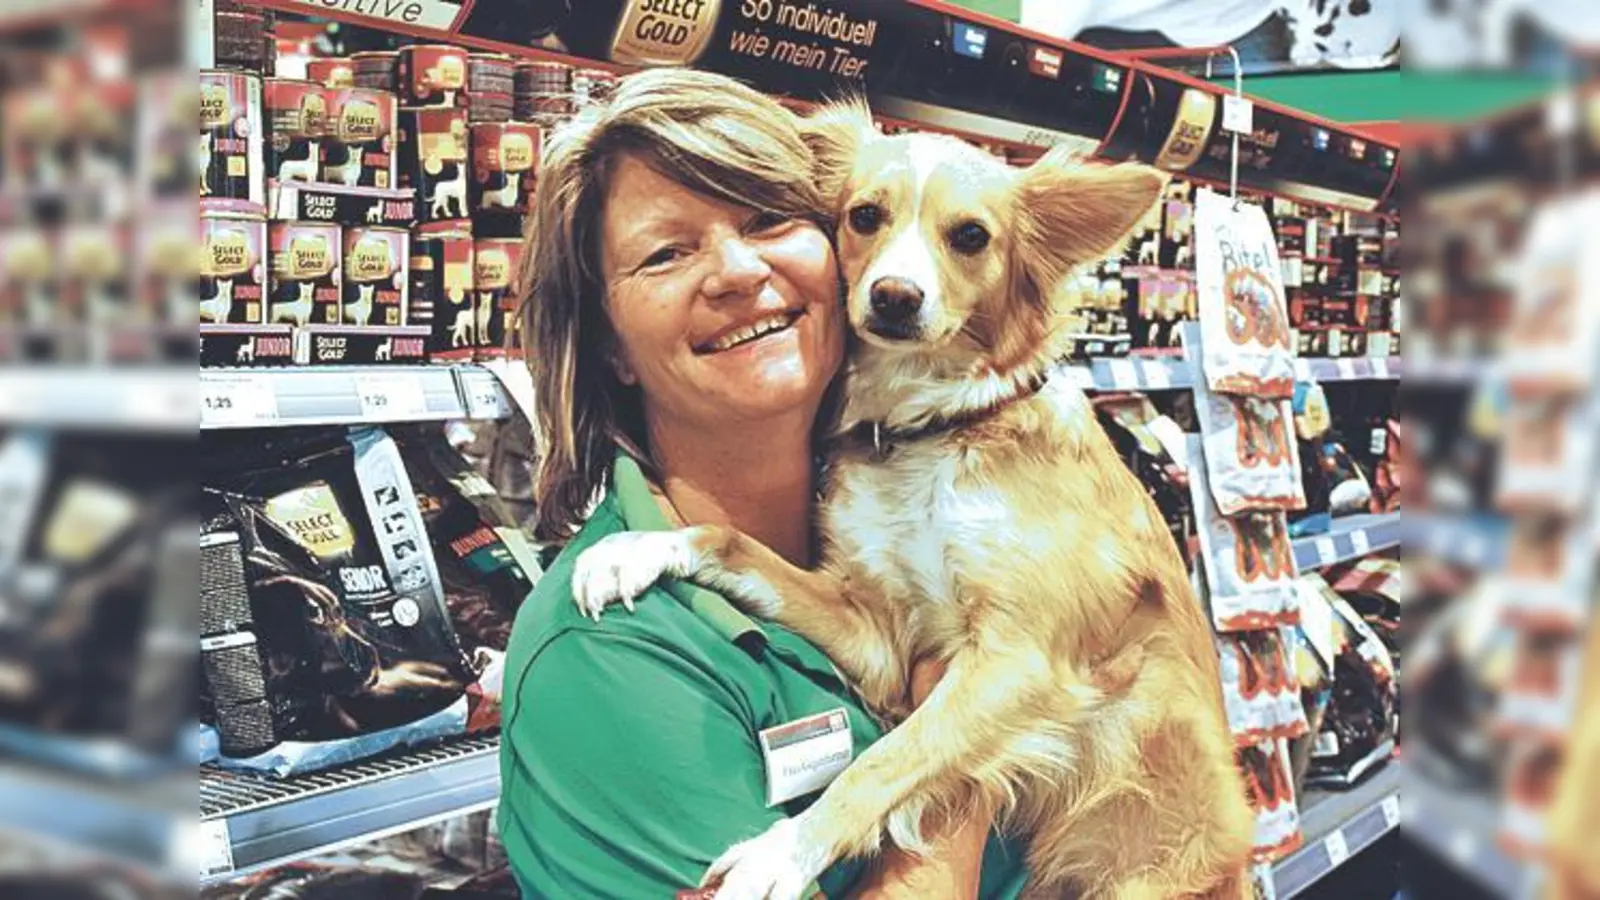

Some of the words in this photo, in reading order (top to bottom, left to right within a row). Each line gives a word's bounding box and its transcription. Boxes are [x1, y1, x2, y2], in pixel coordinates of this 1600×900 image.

[635, 14, 688, 45] GOLD
[741, 0, 773, 21] So
[775, 0, 877, 47] individuell
[730, 27, 770, 57] wie
[771, 40, 826, 70] mein
[829, 46, 868, 79] Tier.
[304, 193, 336, 207] SELECT
[306, 205, 336, 219] GOLD
[316, 336, 347, 348] SELECT
[318, 347, 346, 360] GOLD
[286, 513, 333, 535] SELECT
